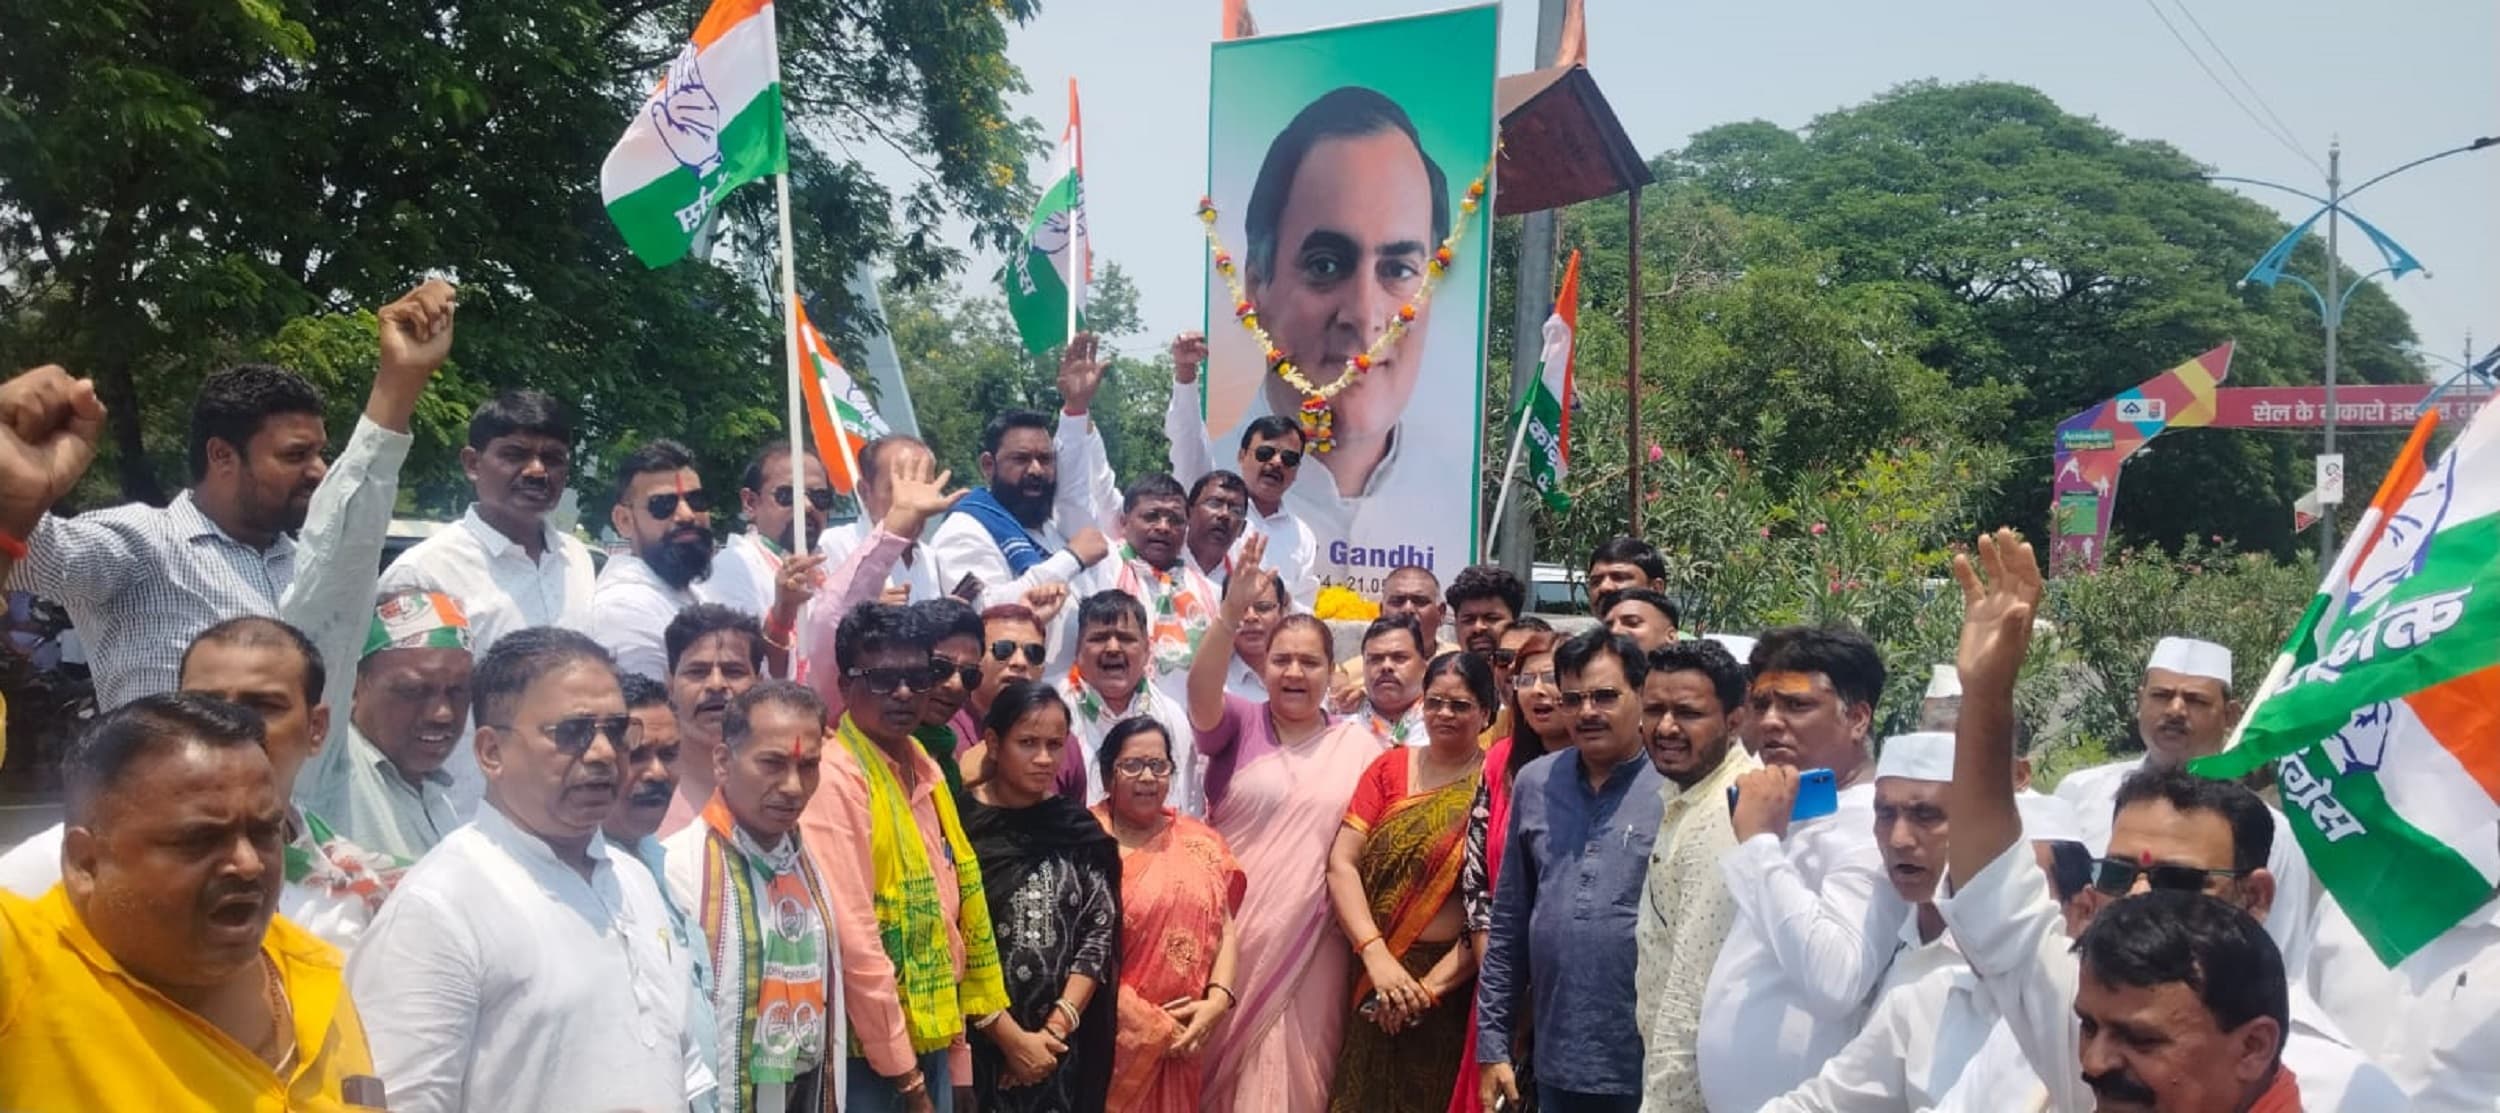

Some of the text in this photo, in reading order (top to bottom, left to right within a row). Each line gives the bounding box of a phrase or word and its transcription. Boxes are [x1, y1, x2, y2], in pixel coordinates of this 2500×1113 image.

[2251, 400, 2292, 422] सेल
[2295, 399, 2315, 421] के
[1329, 540, 1435, 571] Gandhi
[1346, 575, 1385, 593] 21.0
